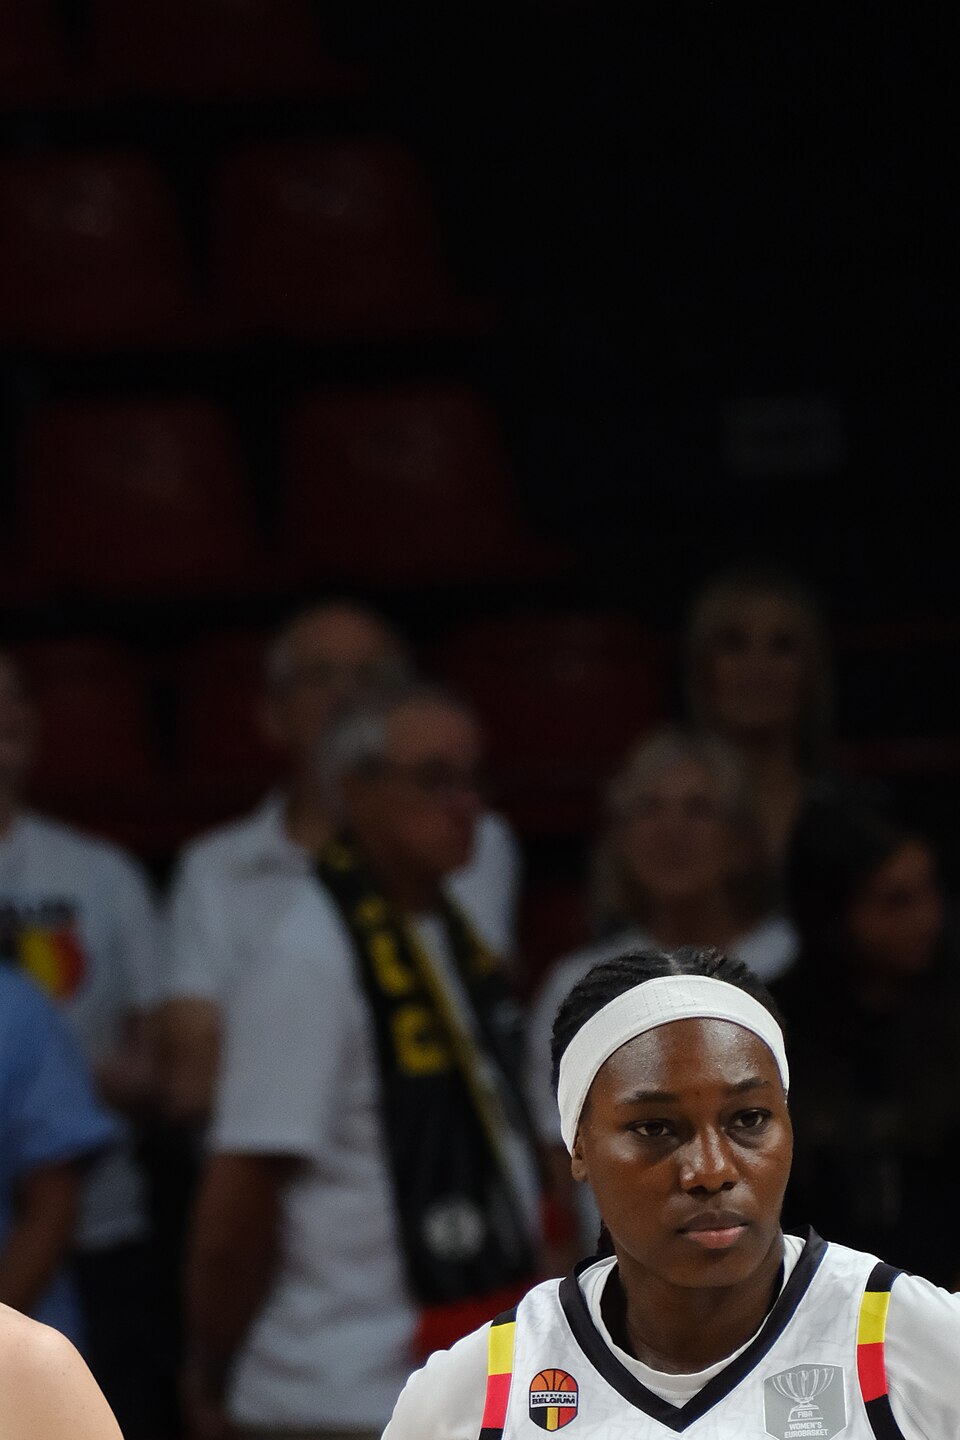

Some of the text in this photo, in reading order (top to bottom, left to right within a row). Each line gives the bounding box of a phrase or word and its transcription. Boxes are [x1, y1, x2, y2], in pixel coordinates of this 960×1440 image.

[532, 1397, 576, 1405] BELGIUM
[797, 1410, 813, 1418] FIBA
[789, 1421, 823, 1430] WOMEN'S
[784, 1428, 828, 1439] EUROBASKET
